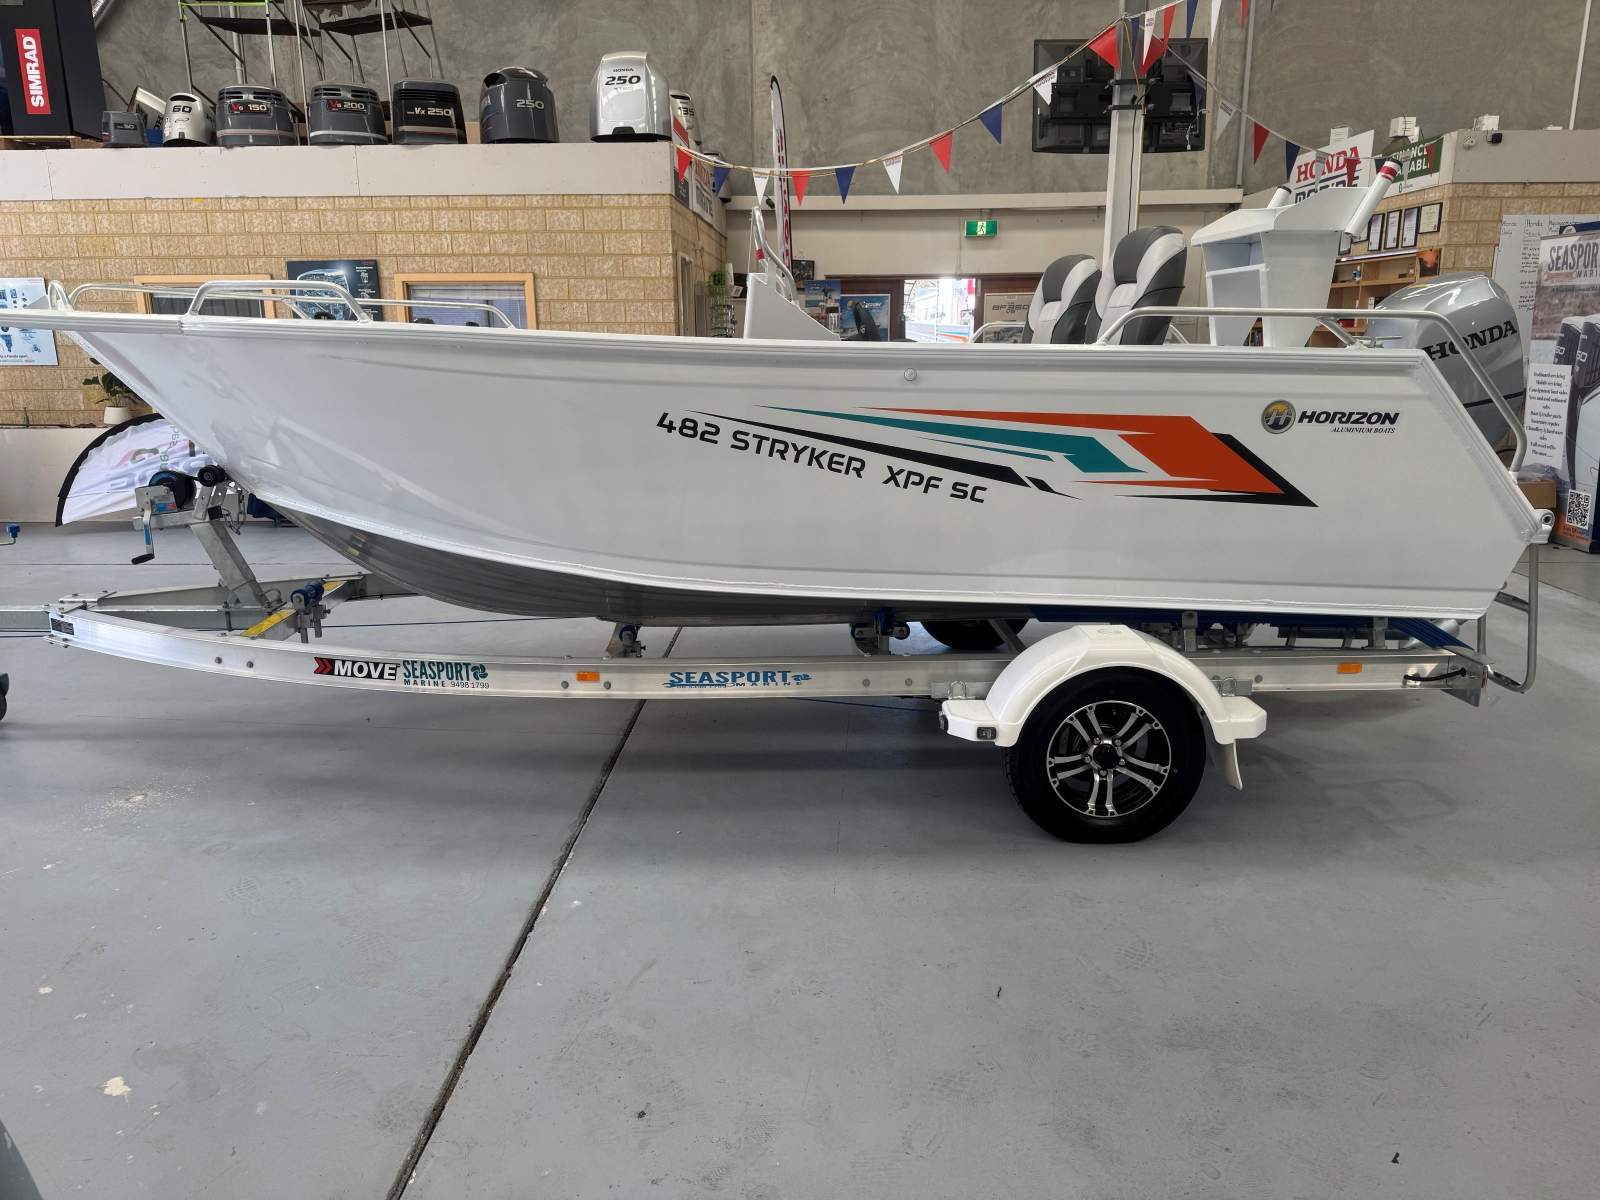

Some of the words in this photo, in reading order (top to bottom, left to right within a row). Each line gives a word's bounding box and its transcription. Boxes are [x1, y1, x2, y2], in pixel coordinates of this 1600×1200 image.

[22, 36, 45, 107] SIMRAD
[605, 75, 641, 86] 250
[172, 105, 192, 114] 60
[344, 101, 365, 110] 200
[516, 99, 545, 109] 250
[428, 107, 452, 117] 250
[1548, 242, 1600, 272] SEASPOR
[1576, 270, 1600, 278] MARI
[1422, 320, 1517, 361] HONDA
[1297, 410, 1400, 425] HORIZON
[656, 412, 721, 445] 482
[730, 430, 866, 478] STRYKER
[882, 465, 943, 494] XPF
[950, 481, 987, 503] SC
[334, 659, 396, 680] MOVE
[402, 660, 471, 681] SEASPORT
[404, 679, 446, 688] MARINE
[669, 670, 792, 684] SEASPORT
